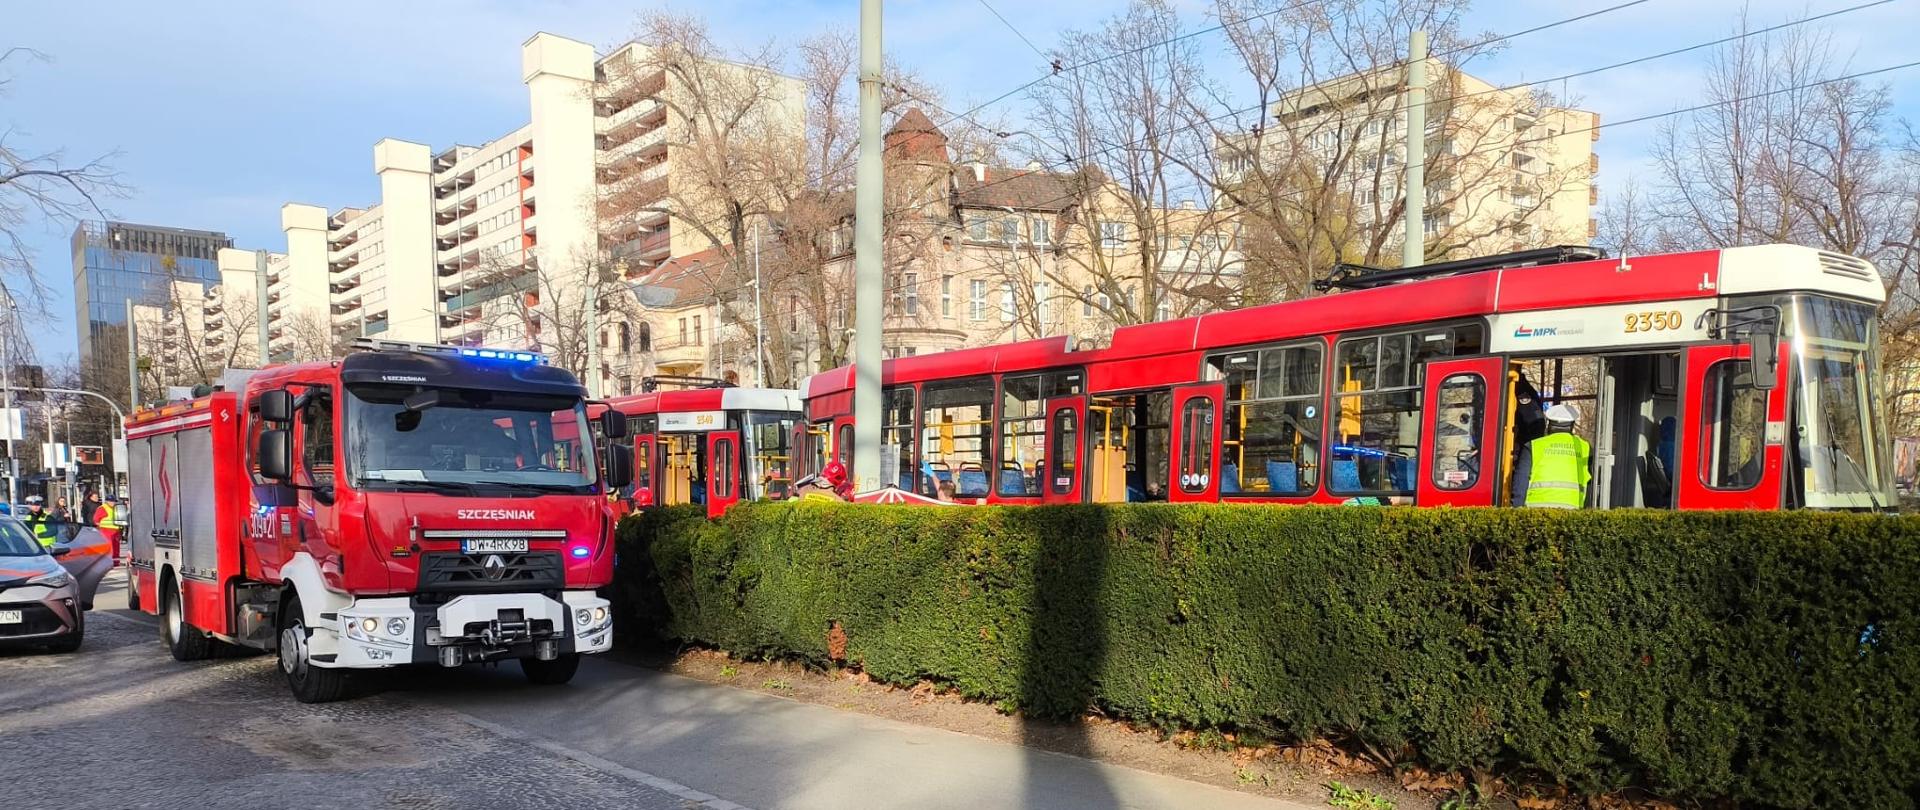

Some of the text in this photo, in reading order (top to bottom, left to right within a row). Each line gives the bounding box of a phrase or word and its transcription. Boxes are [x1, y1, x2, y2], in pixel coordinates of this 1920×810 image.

[1623, 310, 1683, 334] 2350
[1532, 327, 1557, 337] MPK
[457, 508, 535, 521] SZCZĘŚNIAK
